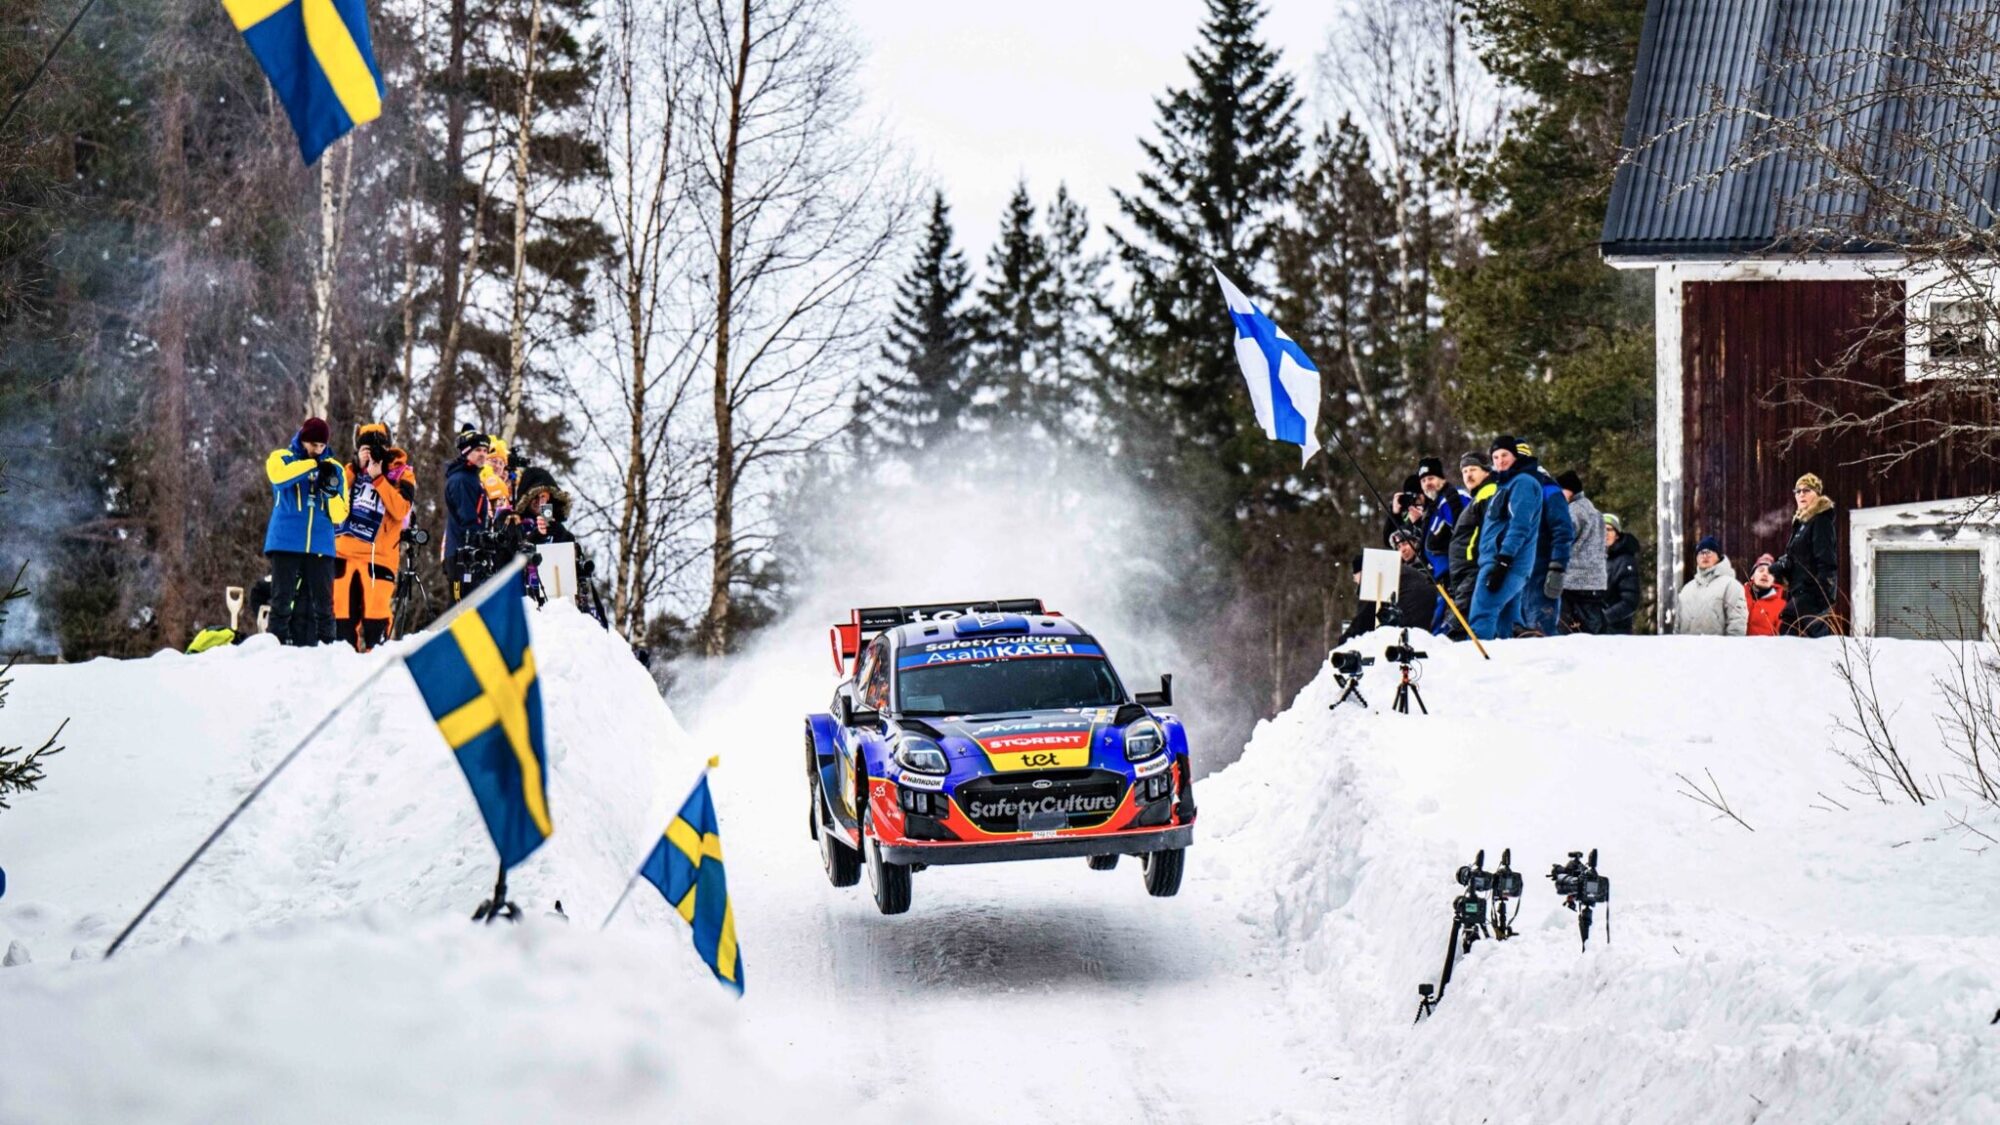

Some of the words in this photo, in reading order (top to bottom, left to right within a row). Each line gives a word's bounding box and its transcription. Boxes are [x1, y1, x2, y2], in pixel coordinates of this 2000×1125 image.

[925, 635, 1068, 652] SafetyCulture
[988, 735, 1082, 749] STORENT
[1020, 752, 1060, 767] tet
[969, 794, 1118, 820] SafetyCulture
